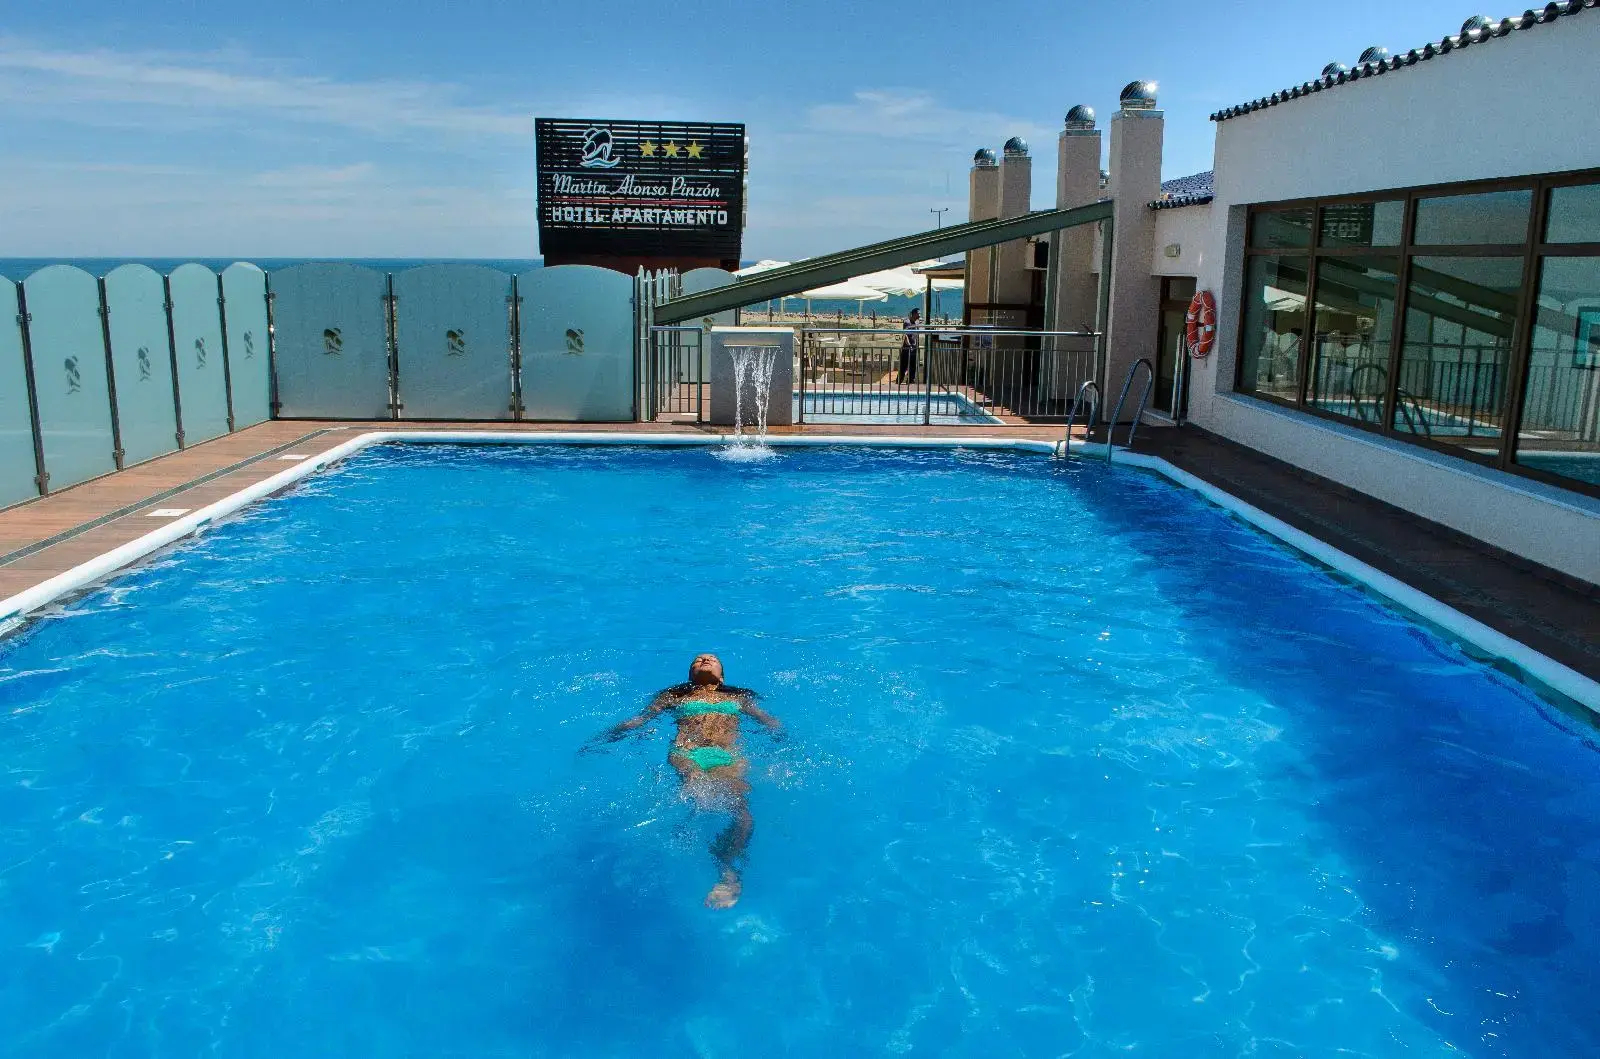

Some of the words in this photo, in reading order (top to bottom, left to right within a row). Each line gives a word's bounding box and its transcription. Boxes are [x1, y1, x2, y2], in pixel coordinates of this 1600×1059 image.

[552, 173, 607, 195] Martín
[609, 175, 667, 196] Alonso
[670, 176, 721, 198] Pinzón
[552, 206, 604, 223] HOTEL
[611, 207, 728, 225] APARTAMENTO
